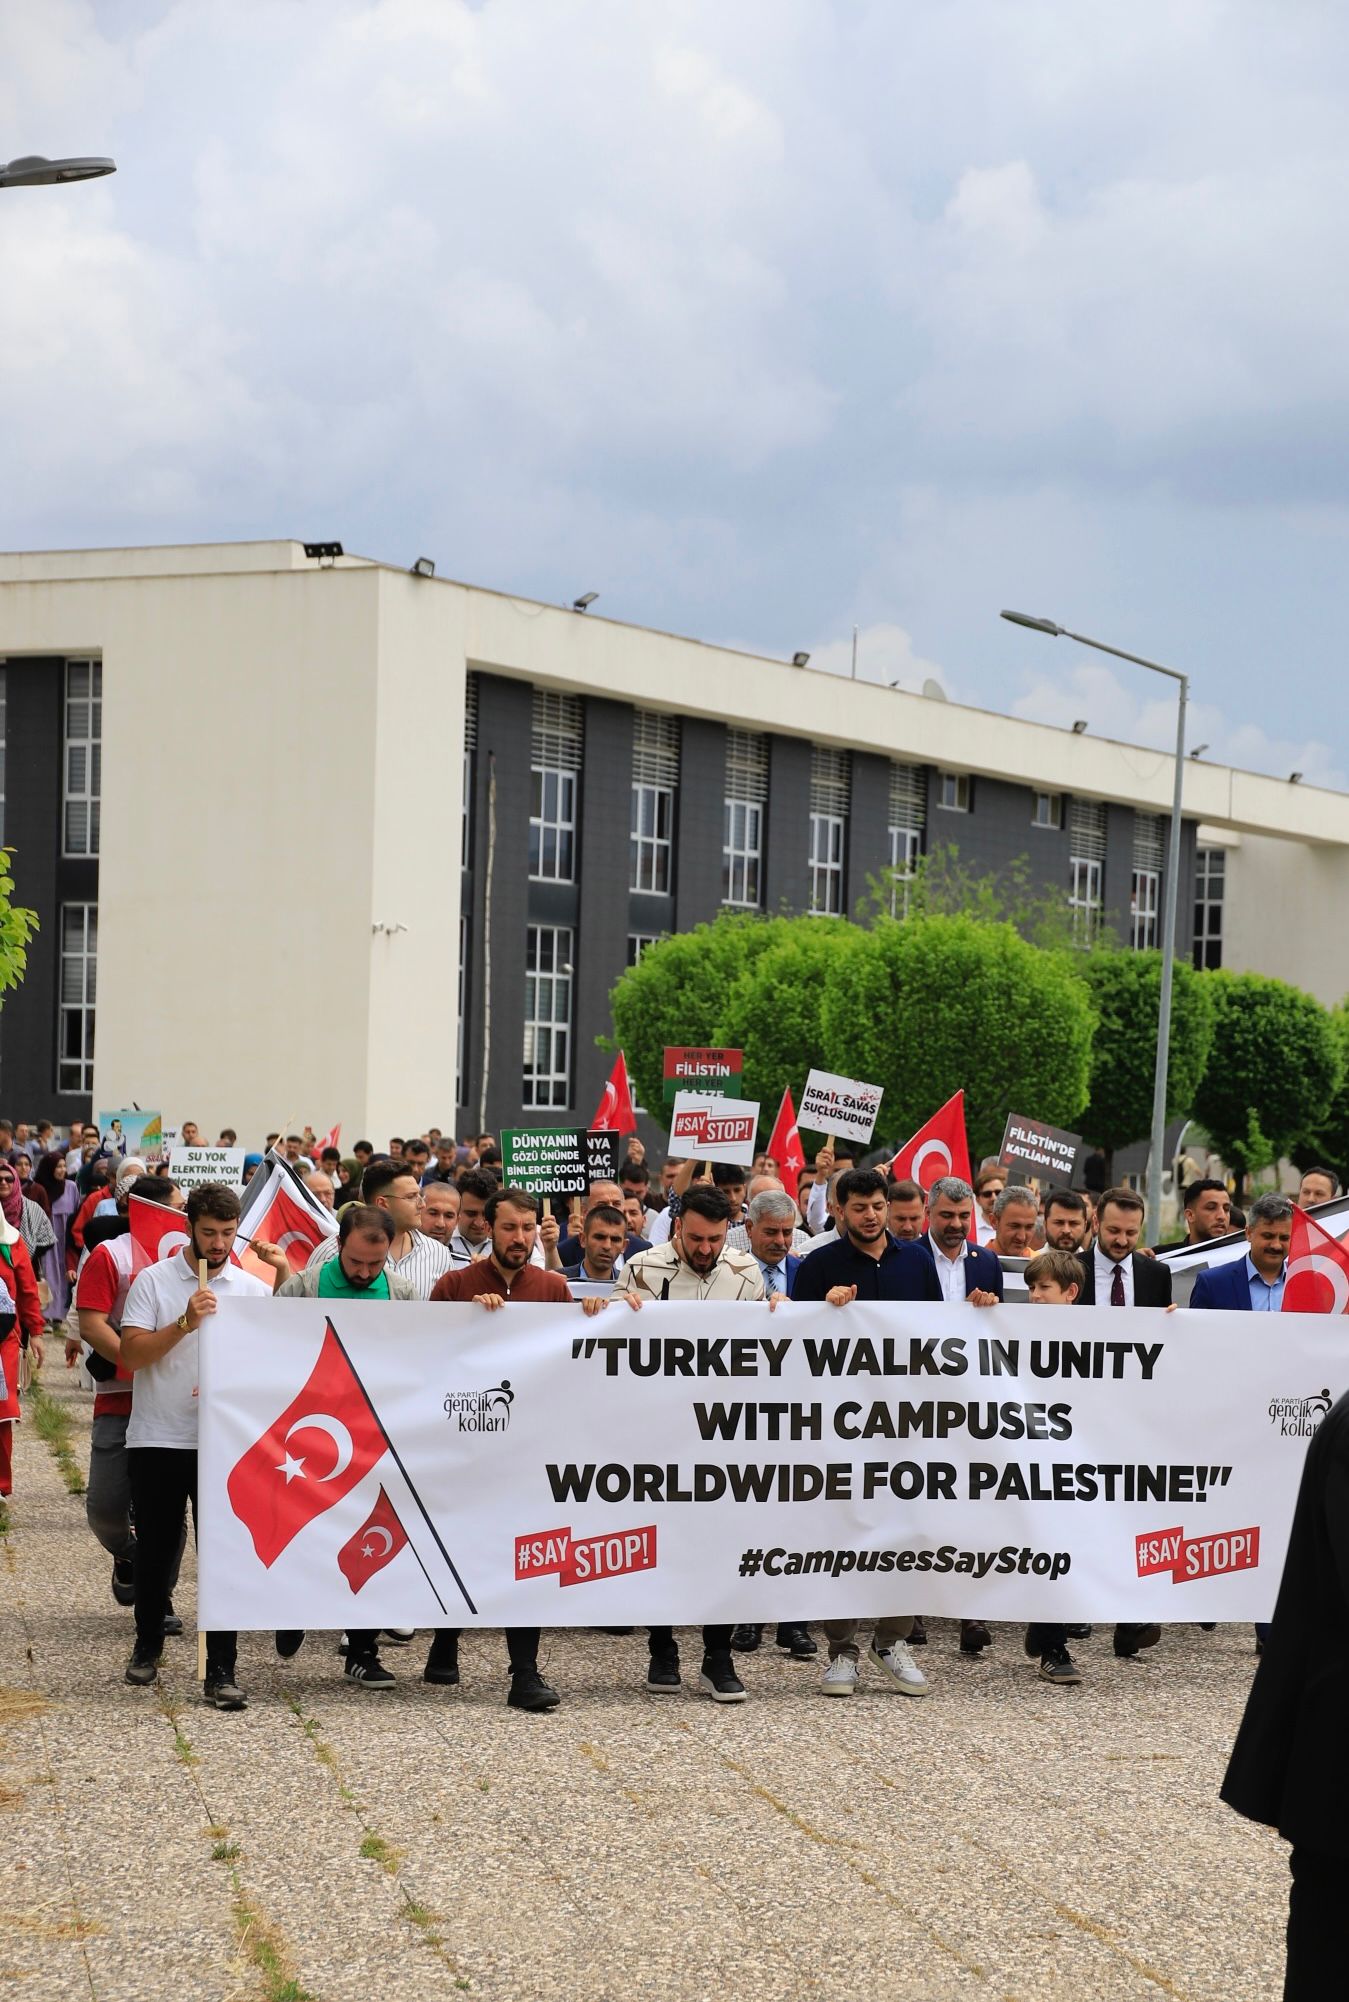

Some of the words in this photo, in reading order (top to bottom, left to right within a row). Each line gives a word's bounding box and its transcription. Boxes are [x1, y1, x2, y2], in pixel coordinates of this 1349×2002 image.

[684, 1052, 702, 1060] HER
[706, 1052, 724, 1061] YER
[675, 1061, 731, 1077] FİLİSTİN
[682, 1078, 702, 1087] HER
[705, 1079, 724, 1087] YER
[803, 1101, 873, 1128] SUÇLUSUDUR
[842, 1097, 877, 1114] SAVAŞ
[512, 1133, 578, 1148] DÜNYANIN
[676, 1116, 706, 1132] #SAY
[707, 1120, 749, 1141] STOP!
[1009, 1127, 1076, 1158] FİLİSTİN'DE
[187, 1152, 202, 1161] SU
[204, 1152, 227, 1161] YOK
[512, 1150, 538, 1162] GÖZÜ
[540, 1149, 580, 1161] ÖNÜNDE
[1005, 1143, 1051, 1165] KATLİAM
[1051, 1158, 1072, 1173] VAR
[171, 1163, 217, 1174] ELEKTRİK
[219, 1165, 240, 1174] YOK
[507, 1164, 552, 1176] BİNLERCE
[553, 1163, 586, 1176] ÇOCUK
[803, 1338, 969, 1377] WALKS
[979, 1338, 1020, 1377] IN
[1030, 1341, 1165, 1380] UNITY
[443, 1393, 493, 1420] gençlik
[445, 1391, 456, 1399] AK
[458, 1412, 505, 1432] kolları
[693, 1403, 822, 1441] WITH
[833, 1401, 1073, 1441] CAMPUSES
[1268, 1400, 1312, 1424] gençlik
[546, 1463, 853, 1503] WORLDWIDE
[863, 1461, 958, 1501] FOR
[517, 1535, 569, 1570] #SAY
[574, 1532, 649, 1578] STOP!
[738, 1546, 1071, 1581] #CampusesSayStop
[1138, 1535, 1182, 1568] #SAY
[1185, 1533, 1252, 1575] STOP!
